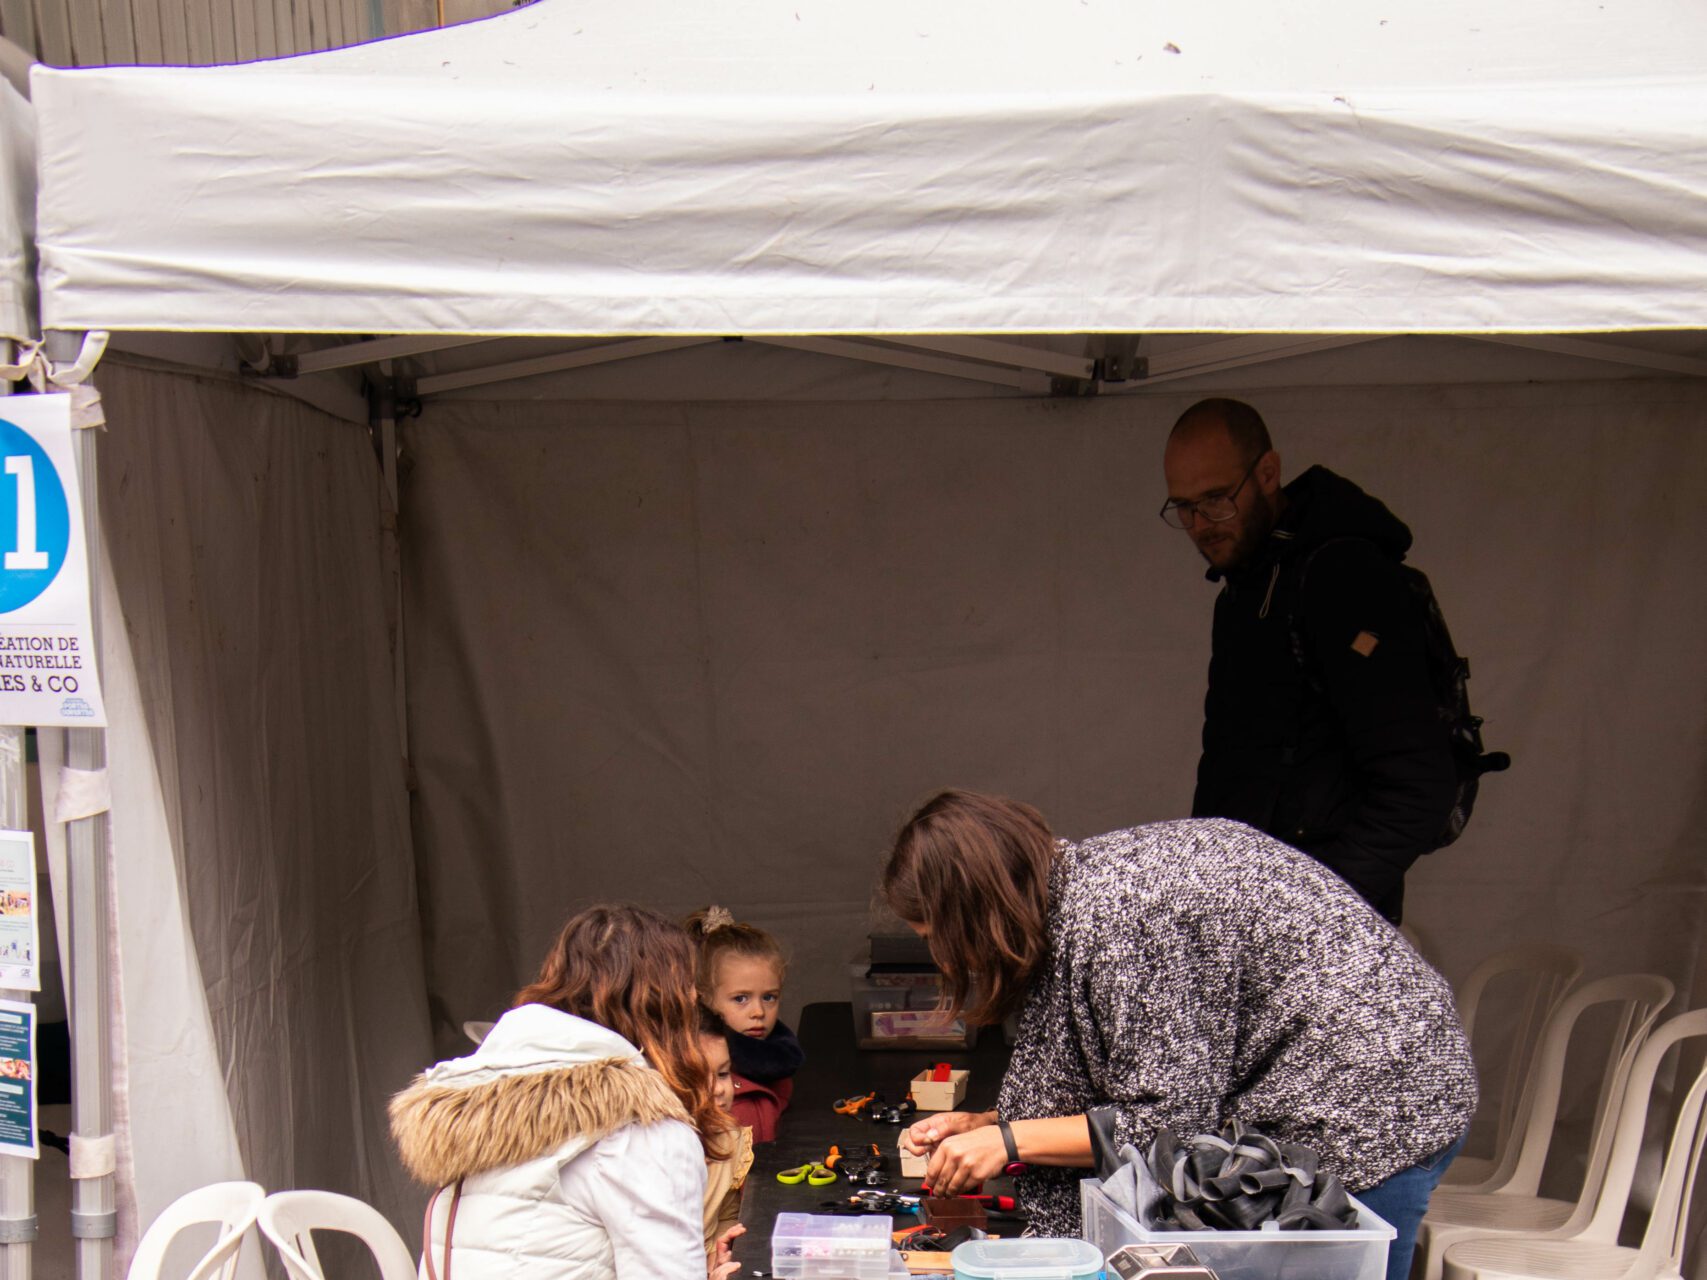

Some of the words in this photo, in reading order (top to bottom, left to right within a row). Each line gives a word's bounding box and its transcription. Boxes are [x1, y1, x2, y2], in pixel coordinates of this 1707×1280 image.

[4, 455, 49, 570] 1
[57, 637, 79, 651] DE
[31, 674, 43, 692] &
[47, 675, 79, 693] CO
